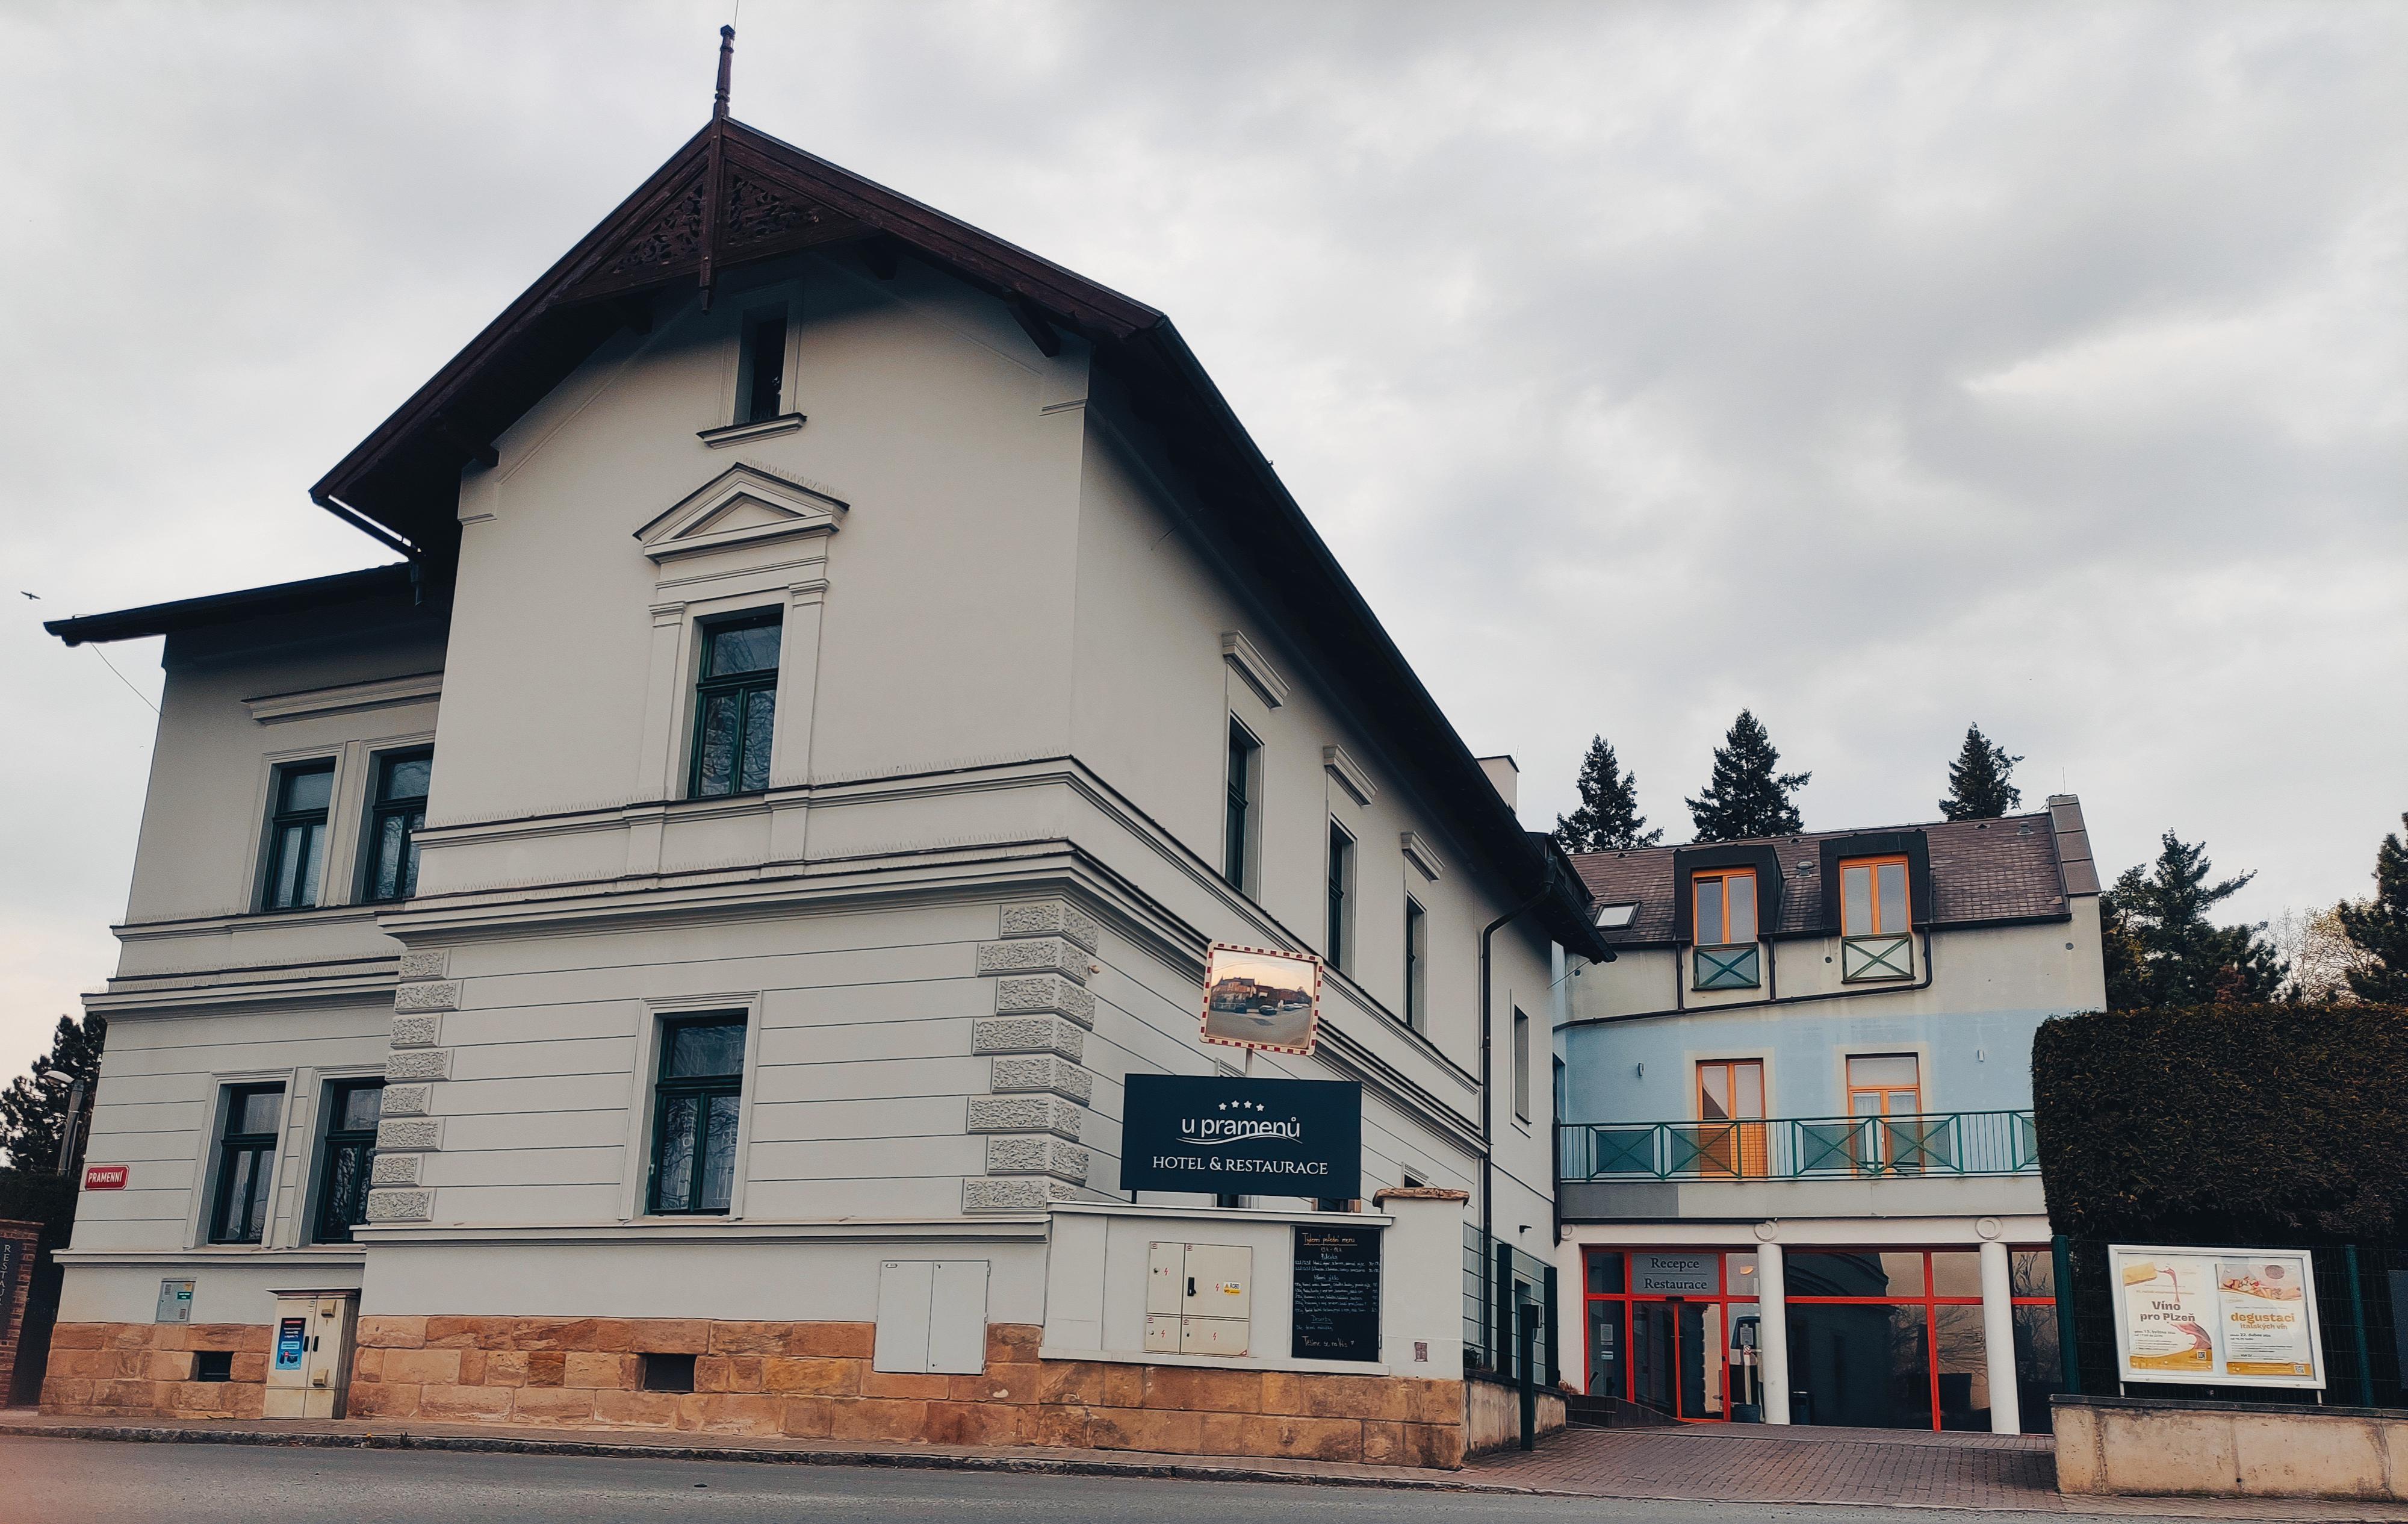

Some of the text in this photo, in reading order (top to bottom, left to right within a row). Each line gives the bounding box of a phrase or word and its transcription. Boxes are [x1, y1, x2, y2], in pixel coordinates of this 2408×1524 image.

[1182, 1116, 1300, 1137] u pramenů
[1152, 1156, 1329, 1175] HOTEL & RESTAURACE
[88, 1170, 124, 1183] PRAMENNÍ
[1651, 1257, 1699, 1272] Recepce
[0, 1245, 11, 1305] RESTA
[1644, 1278, 1707, 1289] Restaurace
[2152, 1301, 2181, 1310] Víno
[2140, 1313, 2195, 1322] pro Plzeň
[2230, 1313, 2295, 1324] degustaci
